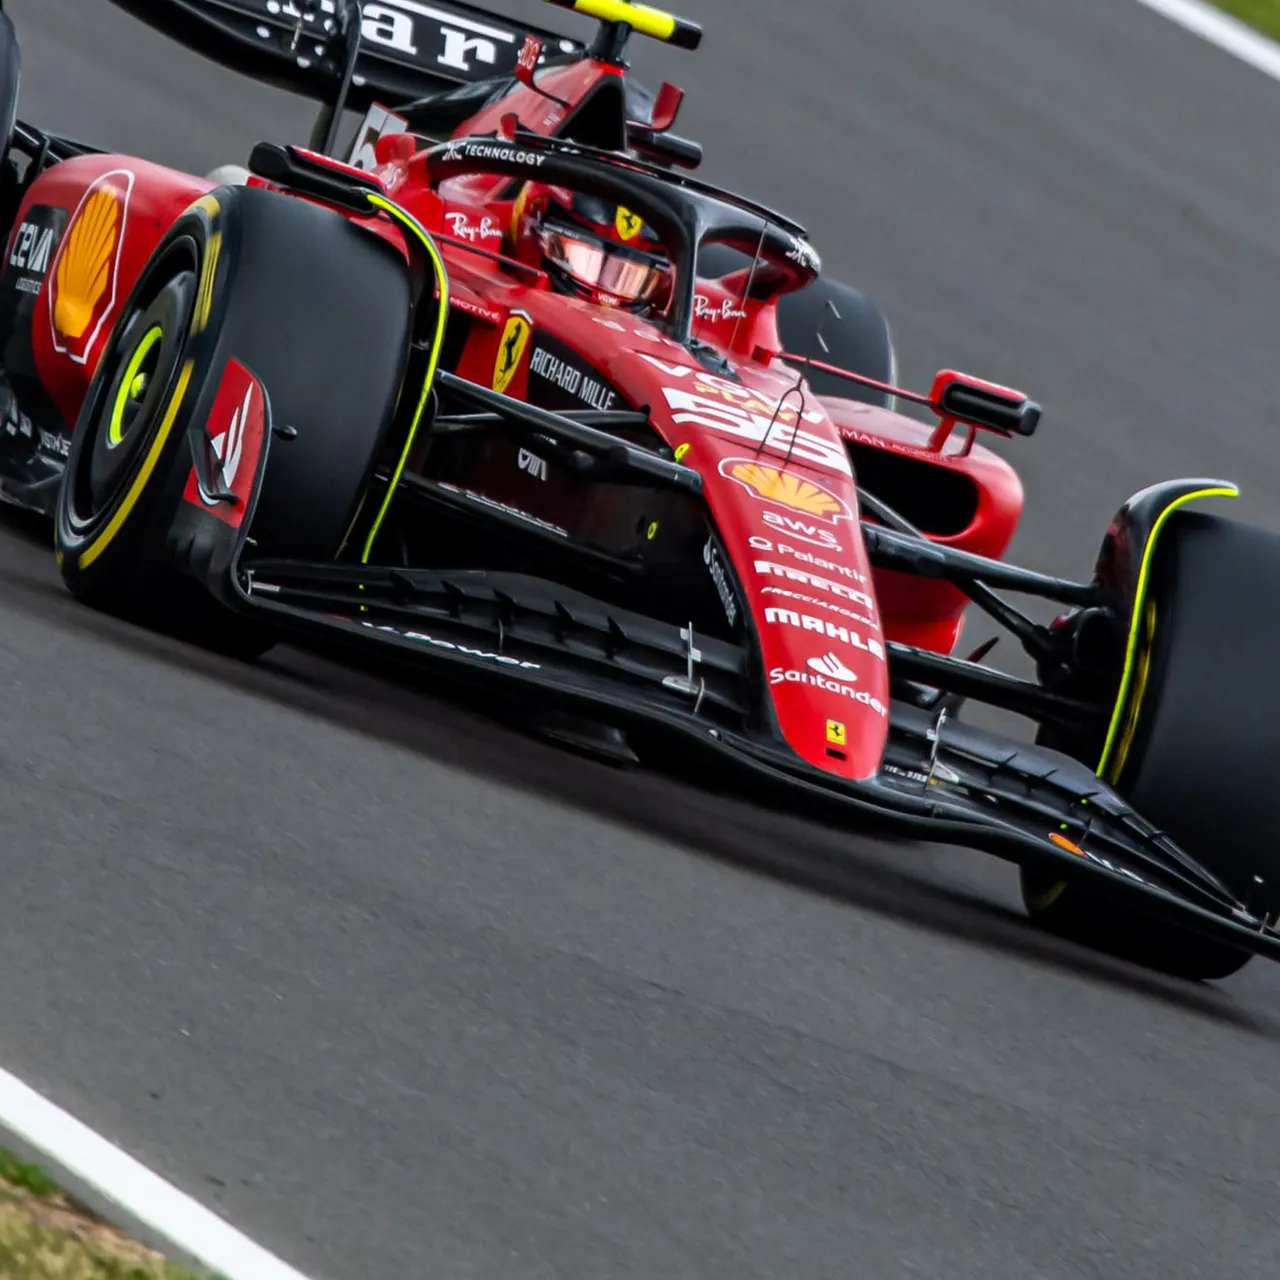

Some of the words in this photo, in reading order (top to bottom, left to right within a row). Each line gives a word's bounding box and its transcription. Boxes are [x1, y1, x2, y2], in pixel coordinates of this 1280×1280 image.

[465, 144, 546, 166] TECHNOLOGY
[10, 222, 53, 274] CEVA
[529, 347, 581, 395] RICHARD
[577, 375, 616, 411] MILLE
[661, 386, 854, 478] 55
[762, 510, 838, 544] aws
[776, 543, 868, 584] Palantir
[764, 607, 885, 661] MAHLE
[770, 667, 888, 718] Santander
